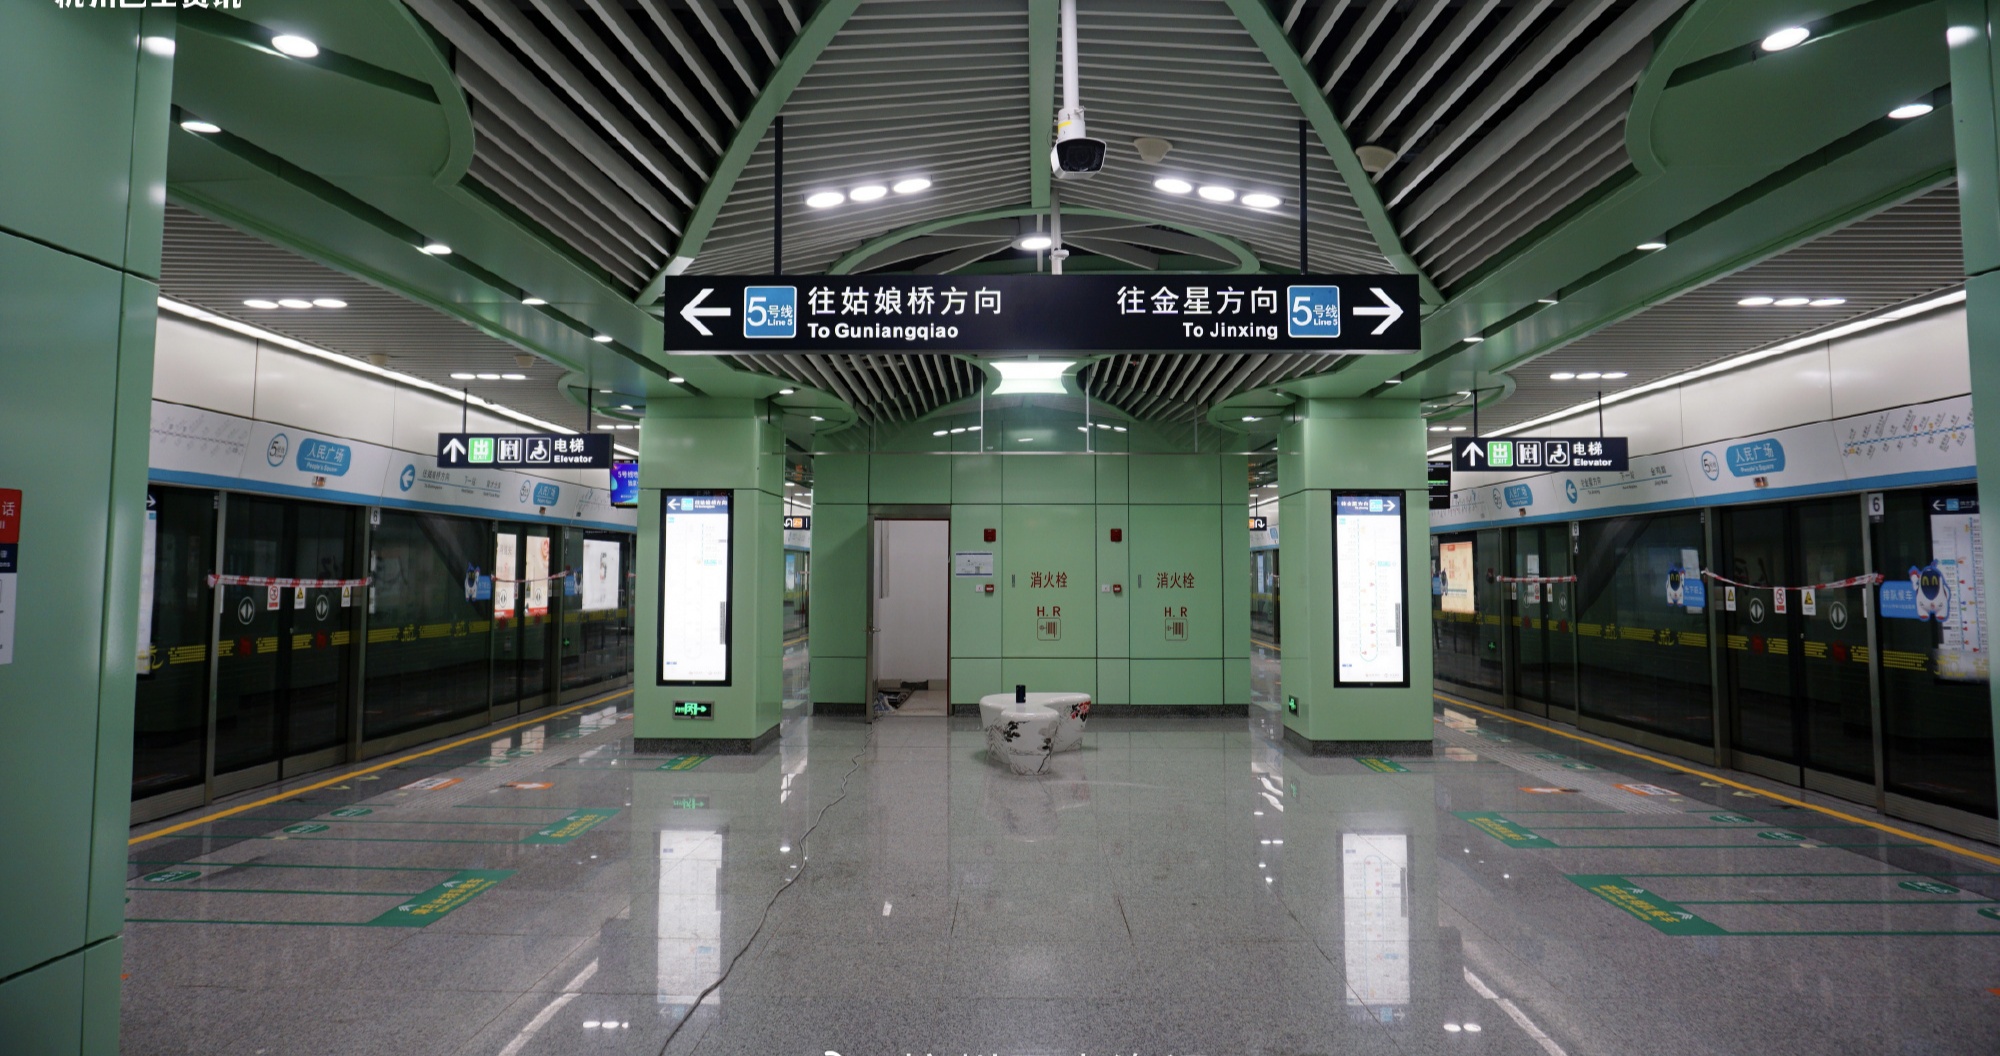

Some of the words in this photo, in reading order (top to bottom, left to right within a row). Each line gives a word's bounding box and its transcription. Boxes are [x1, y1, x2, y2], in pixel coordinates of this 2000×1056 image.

[808, 287, 1001, 315] 往姑娘桥方向
[1117, 286, 1277, 315] 往金星方向
[808, 323, 830, 338] To
[835, 323, 958, 340] Guniangqiao
[1183, 322, 1203, 338] To
[1210, 322, 1278, 340] Jinxing
[306, 442, 345, 463] 人民广场
[554, 438, 584, 452] 电梯
[1573, 441, 1602, 456] 电梯
[1736, 442, 1774, 463] 人民广场
[554, 455, 592, 463] Elevator
[2, 502, 15, 516] 话
[1873, 497, 1880, 512] 6
[373, 510, 378, 522] 6
[1030, 571, 1068, 589] 消火栓
[1156, 572, 1195, 589] 消火栓
